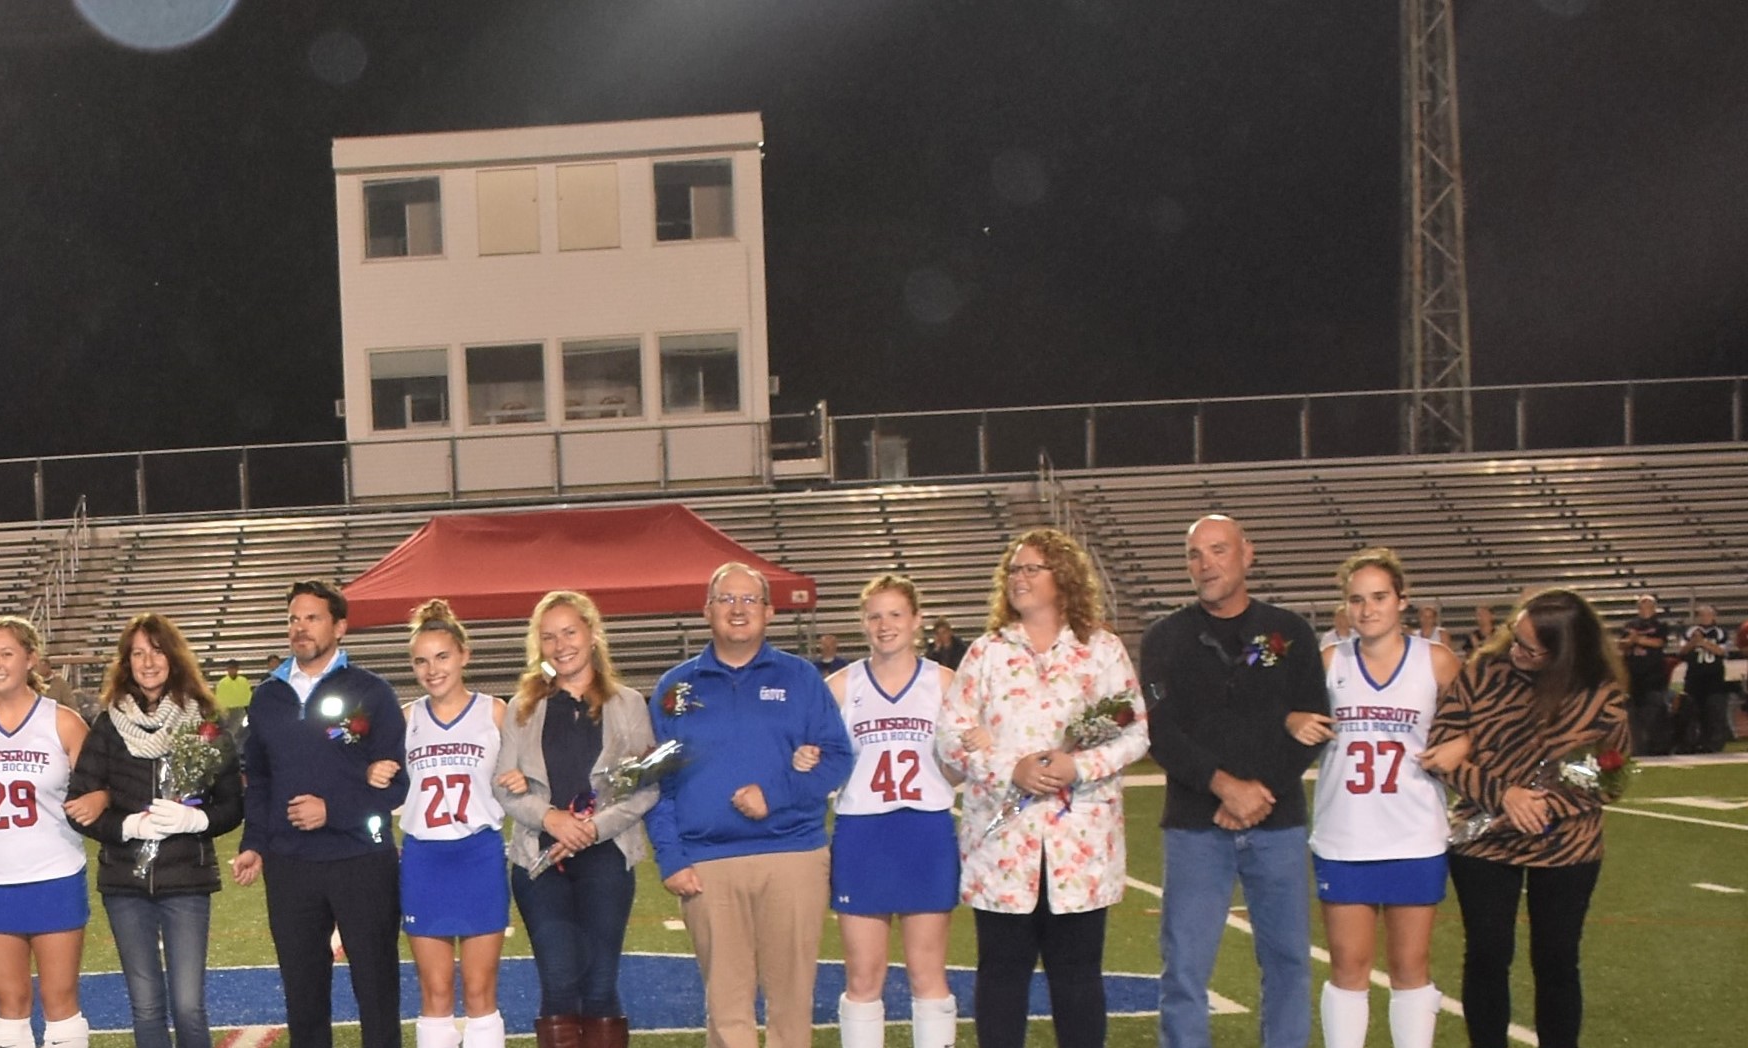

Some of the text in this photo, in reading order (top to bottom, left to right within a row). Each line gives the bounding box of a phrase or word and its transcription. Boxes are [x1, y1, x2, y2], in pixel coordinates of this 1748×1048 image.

[1335, 706, 1420, 724] SELINSGROVE
[853, 717, 934, 738] SELINSGROVE
[1339, 722, 1413, 733] FIELD HOCKEY
[860, 731, 929, 746] FIELD HOCKEY
[408, 743, 485, 764] SELINSGROVE
[2, 762, 45, 774] HOCKEY
[412, 756, 480, 771] FIELD HOCKEY
[1346, 741, 1406, 794] 37
[870, 750, 922, 802] 42
[421, 774, 471, 828] 27
